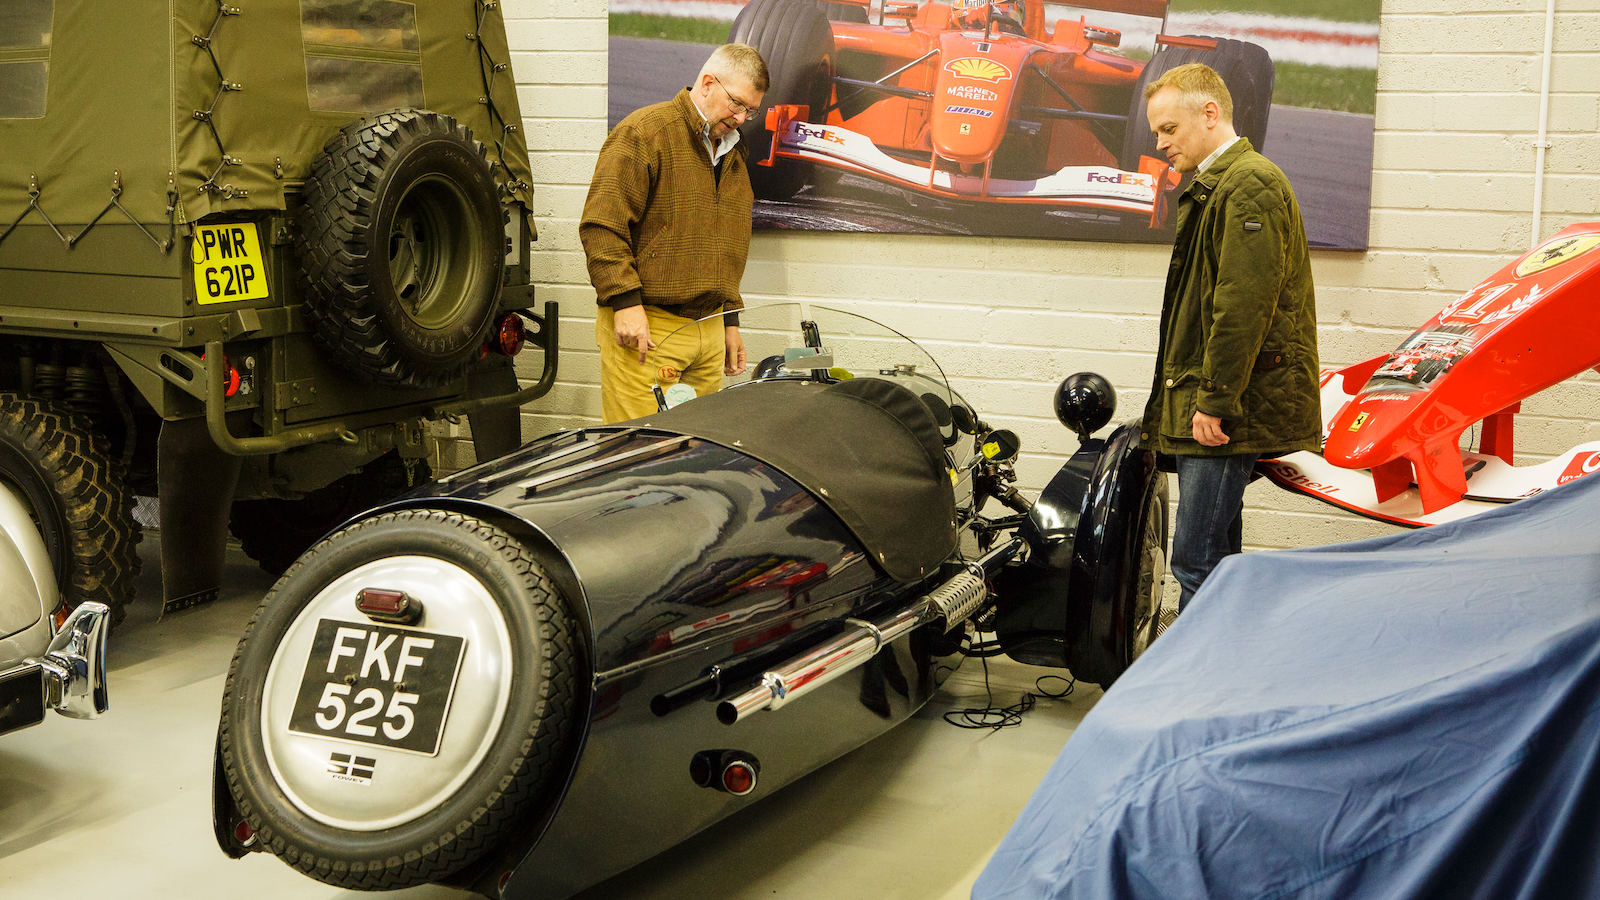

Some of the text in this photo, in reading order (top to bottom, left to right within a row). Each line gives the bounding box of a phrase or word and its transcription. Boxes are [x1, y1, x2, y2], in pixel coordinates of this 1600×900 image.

[947, 86, 998, 97] MAGNETI
[947, 87, 998, 101] MARELLI
[795, 122, 846, 146] FedEx
[1087, 172, 1146, 186] FedEx
[202, 228, 248, 260] PWR
[1450, 282, 1519, 319] 1
[1276, 465, 1341, 494] Shell
[326, 627, 435, 683] FKF
[315, 682, 420, 740] 525
[332, 774, 365, 784] FOWEY
